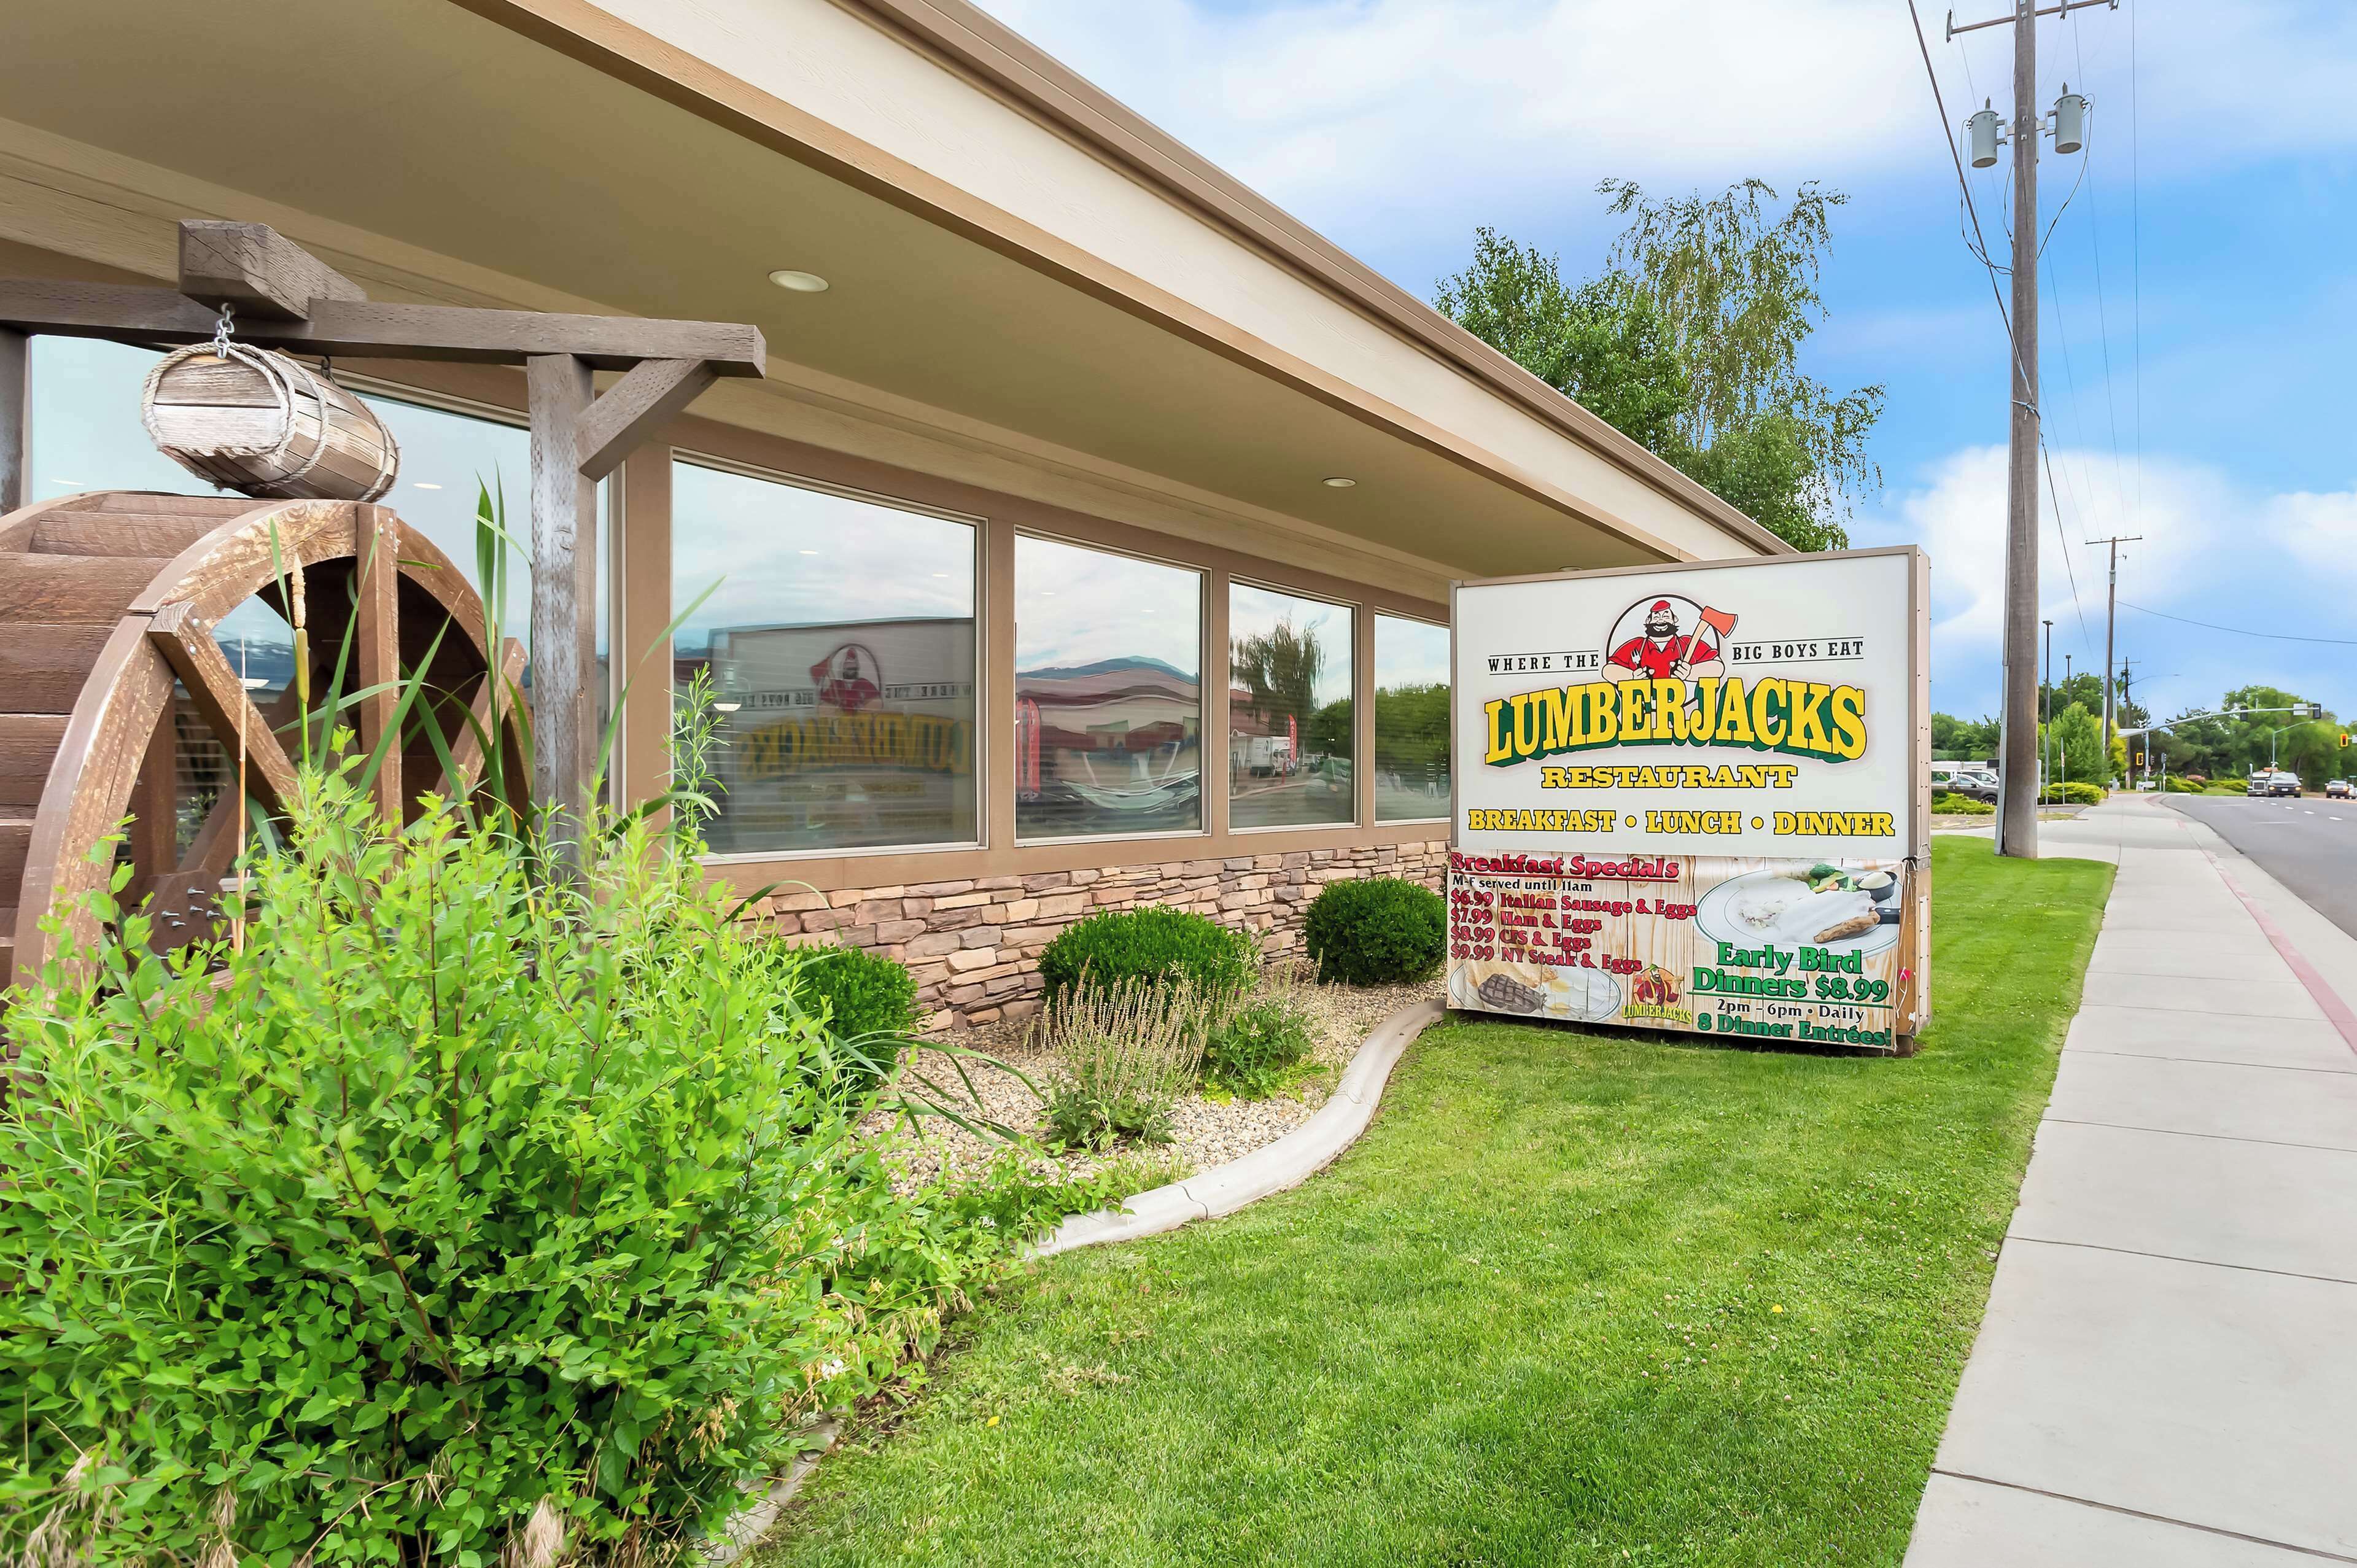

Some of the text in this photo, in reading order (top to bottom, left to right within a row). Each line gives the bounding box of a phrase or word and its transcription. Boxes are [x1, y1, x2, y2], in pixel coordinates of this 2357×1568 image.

[1488, 640, 1864, 672] WHERE THE BIG BOYS EAT
[1484, 677, 1866, 766] LUMBERJACKS
[1541, 766, 1798, 788] RESTAURANT
[1468, 809, 1895, 837] BREAKFAST LUNCH DINNER
[1451, 852, 1679, 879] Breakfast Specials
[1453, 875, 1592, 891] M-F served until 11am
[1451, 888, 1697, 920] $6.99 Italian Sausage & Eggs
[1451, 906, 1602, 934] $7.99 Ham & Eggs
[1451, 924, 1496, 943] $8.99
[1531, 931, 1548, 946] &
[1552, 932, 1591, 952] Eggs
[1451, 942, 1643, 975] $9.99 NY Steak & Eggs
[1717, 941, 1863, 976] Early Bird
[1693, 967, 1889, 1002] Dinners $8.99
[1717, 999, 1750, 1014] 2pm
[1767, 1003, 1802, 1019] 6pm
[1819, 1005, 1865, 1023] Daily
[1697, 1013, 1892, 1047] 8 Dinner Entrées!
